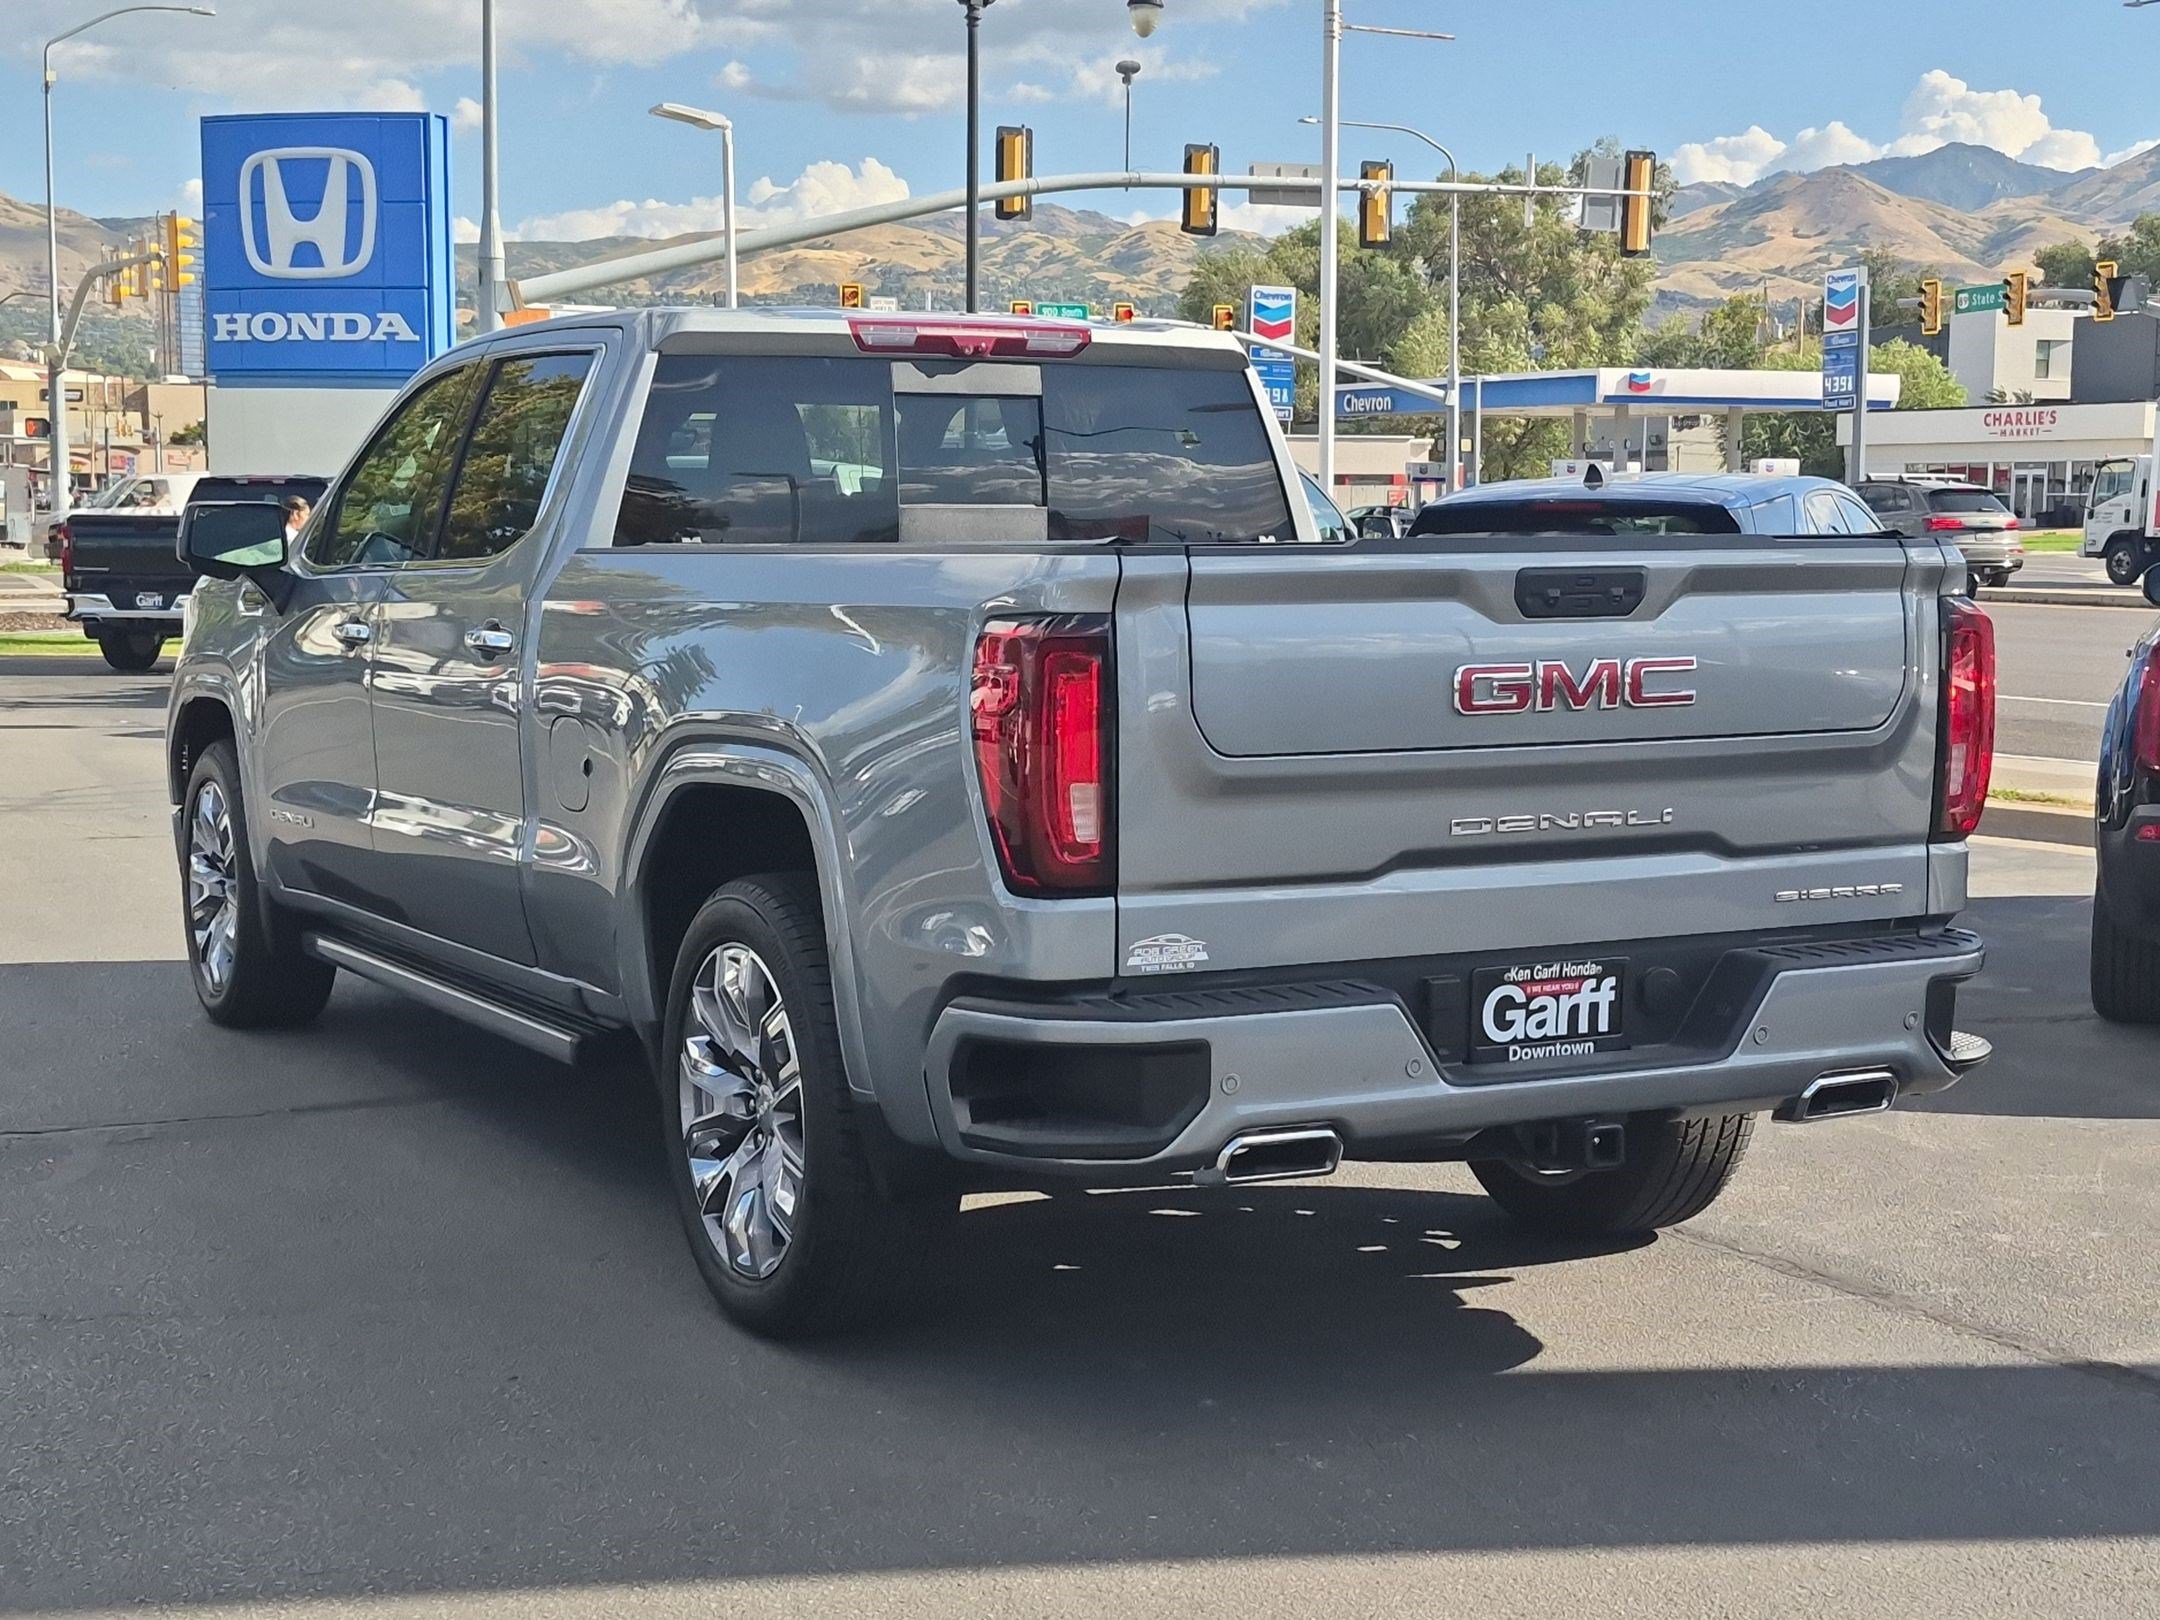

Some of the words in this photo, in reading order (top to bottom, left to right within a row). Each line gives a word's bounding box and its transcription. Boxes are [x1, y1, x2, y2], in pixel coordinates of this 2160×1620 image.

[1827, 274, 1856, 285] Chevron
[1254, 290, 1292, 301] Chevron
[1972, 292, 1995, 306] State
[1998, 290, 2005, 302] S
[213, 312, 420, 341] HONDA
[1343, 393, 1391, 413] Chevron
[1984, 410, 2057, 427] CHARLIE'S
[2000, 427, 2040, 437] MARKET
[1454, 655, 1697, 715] GMC
[1450, 807, 1673, 836] DENALI
[1775, 883, 1902, 902] SIERRA
[1510, 967, 1530, 981] Ken
[1534, 964, 1560, 980] Garff
[1562, 961, 1597, 977] Honda
[1482, 976, 1616, 1042] Garff
[1509, 1042, 1594, 1062] Downtown
